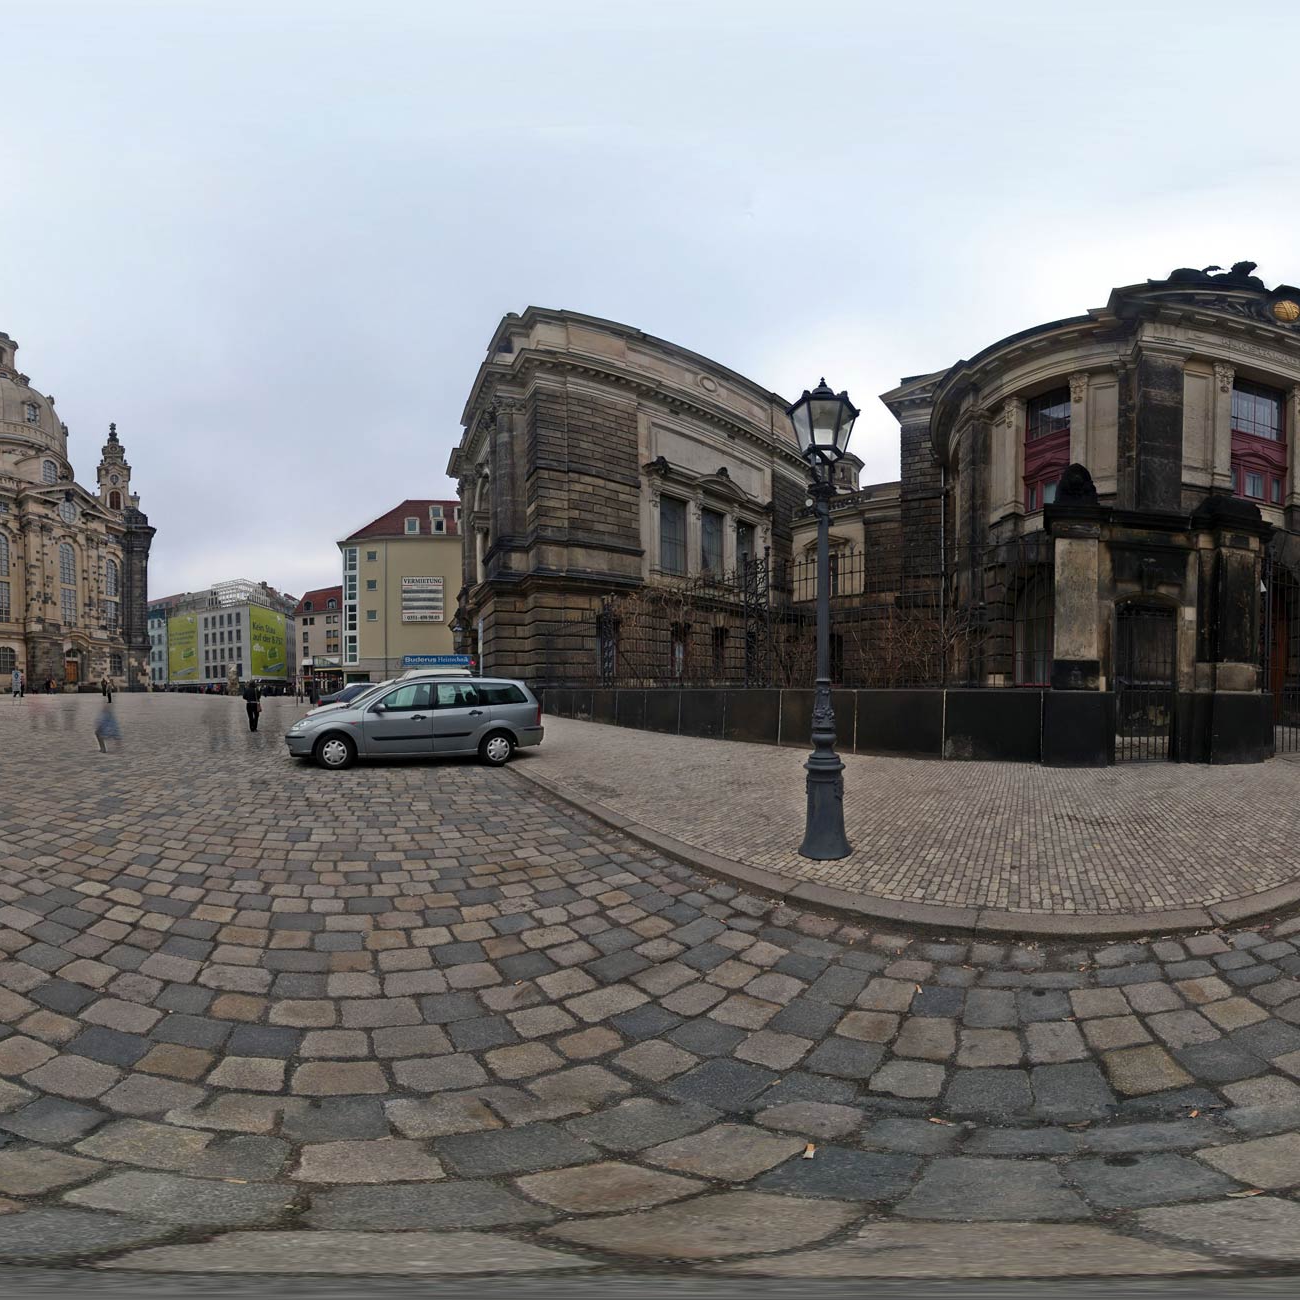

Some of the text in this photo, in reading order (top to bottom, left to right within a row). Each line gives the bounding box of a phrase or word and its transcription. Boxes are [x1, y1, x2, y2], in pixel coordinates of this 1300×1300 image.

[252, 621, 276, 634] Kein Stau
[253, 633, 262, 641] auf
[262, 634, 271, 643] der
